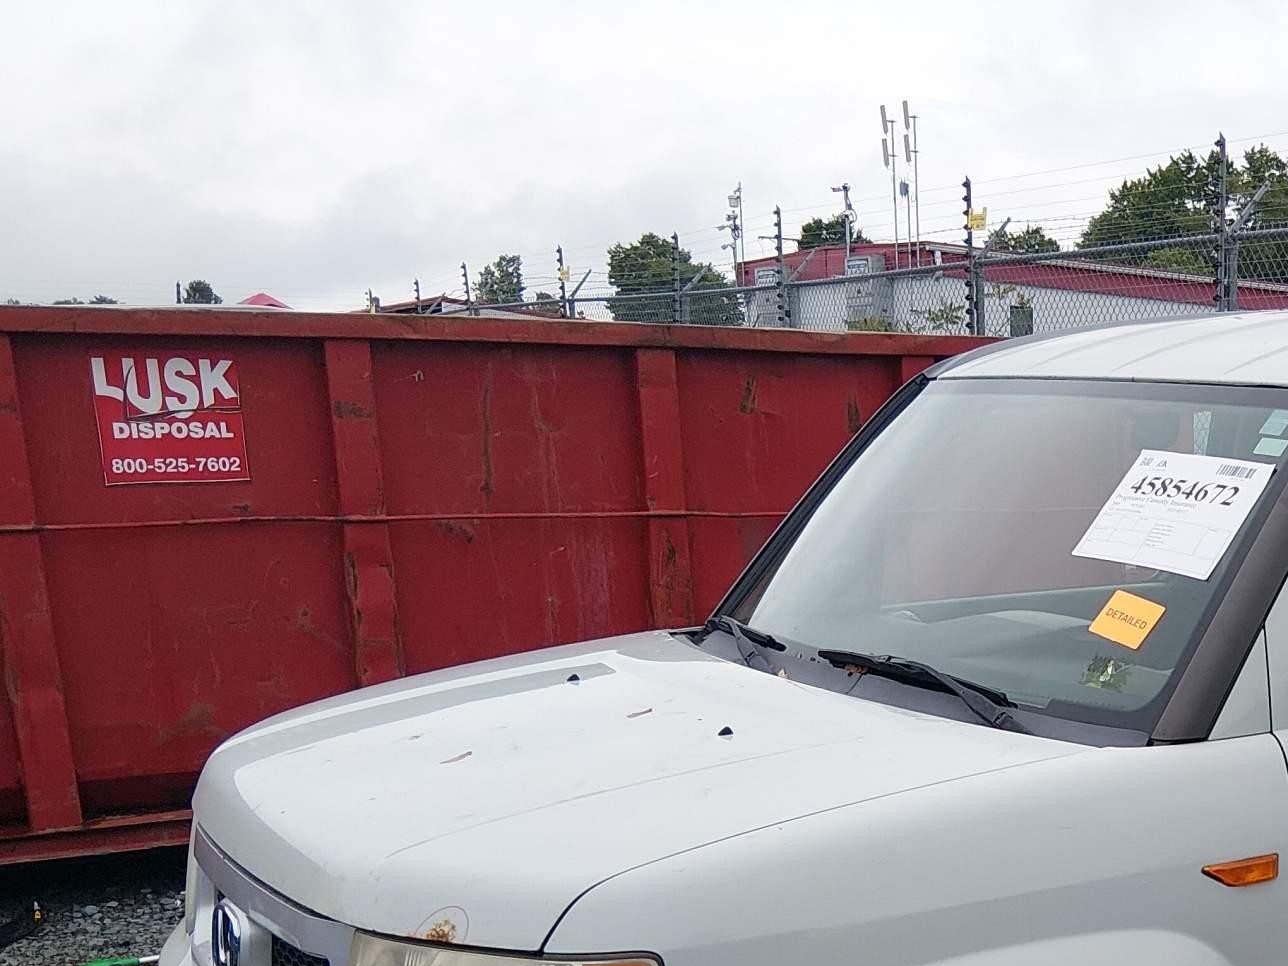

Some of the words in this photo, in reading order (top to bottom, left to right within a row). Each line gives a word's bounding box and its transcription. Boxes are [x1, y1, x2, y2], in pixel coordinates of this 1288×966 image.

[91, 357, 237, 419] LUSK
[112, 422, 234, 439] DISPOSAL
[112, 457, 240, 473] 800-525-7602
[1130, 475, 1240, 506] 45854672
[1105, 607, 1148, 630] DETAILED
